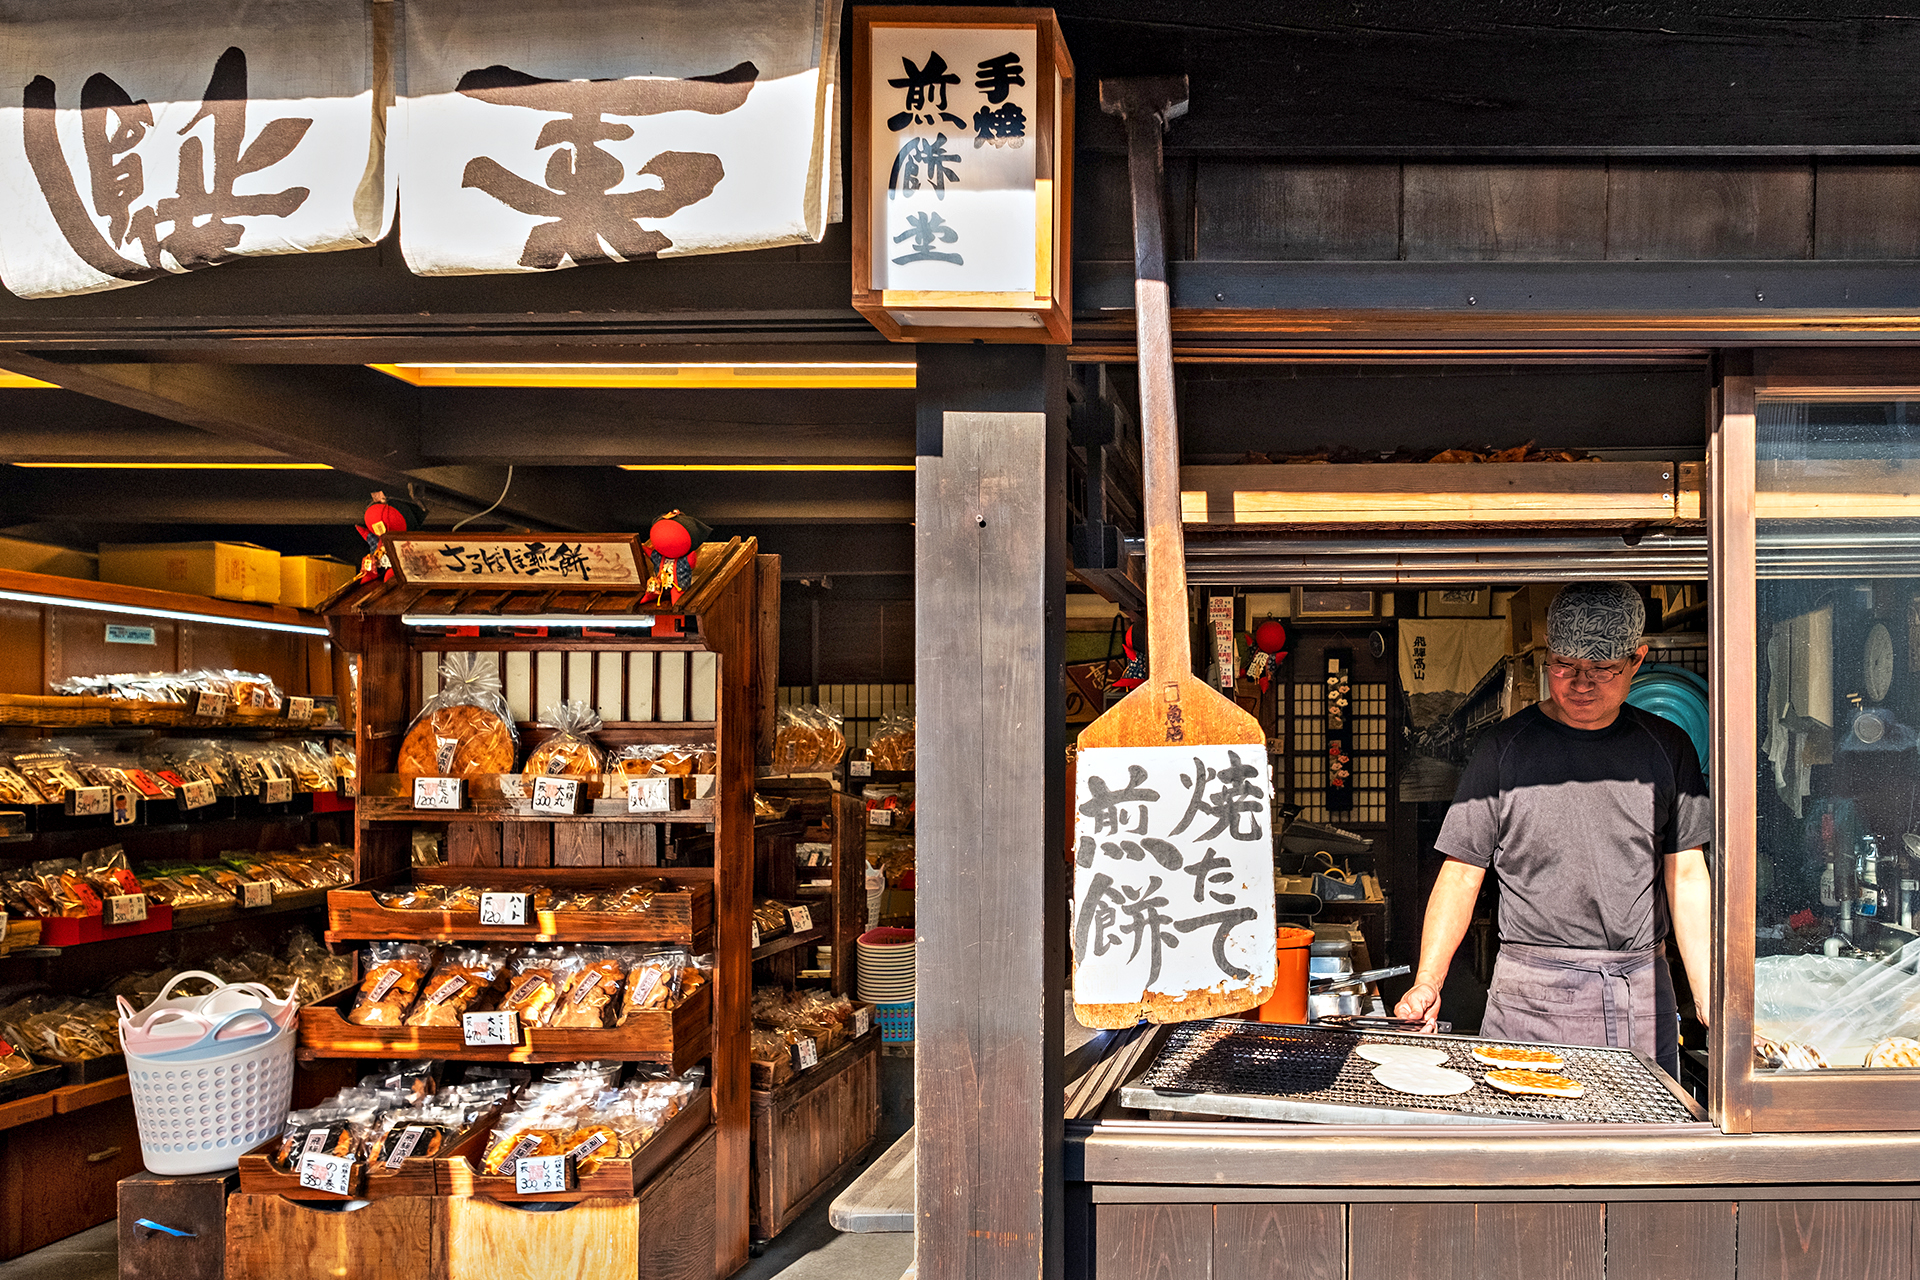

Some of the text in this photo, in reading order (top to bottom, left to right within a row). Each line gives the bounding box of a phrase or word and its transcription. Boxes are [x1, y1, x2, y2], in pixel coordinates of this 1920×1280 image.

[886, 50, 967, 266] 煎餅堂
[553, 784, 565, 807] 大丸
[1168, 750, 1264, 980] 焼たて
[1075, 765, 1184, 1003] 煎餅
[482, 910, 501, 923] 120
[466, 1029, 482, 1042] 470
[520, 1177, 538, 1190] 300
